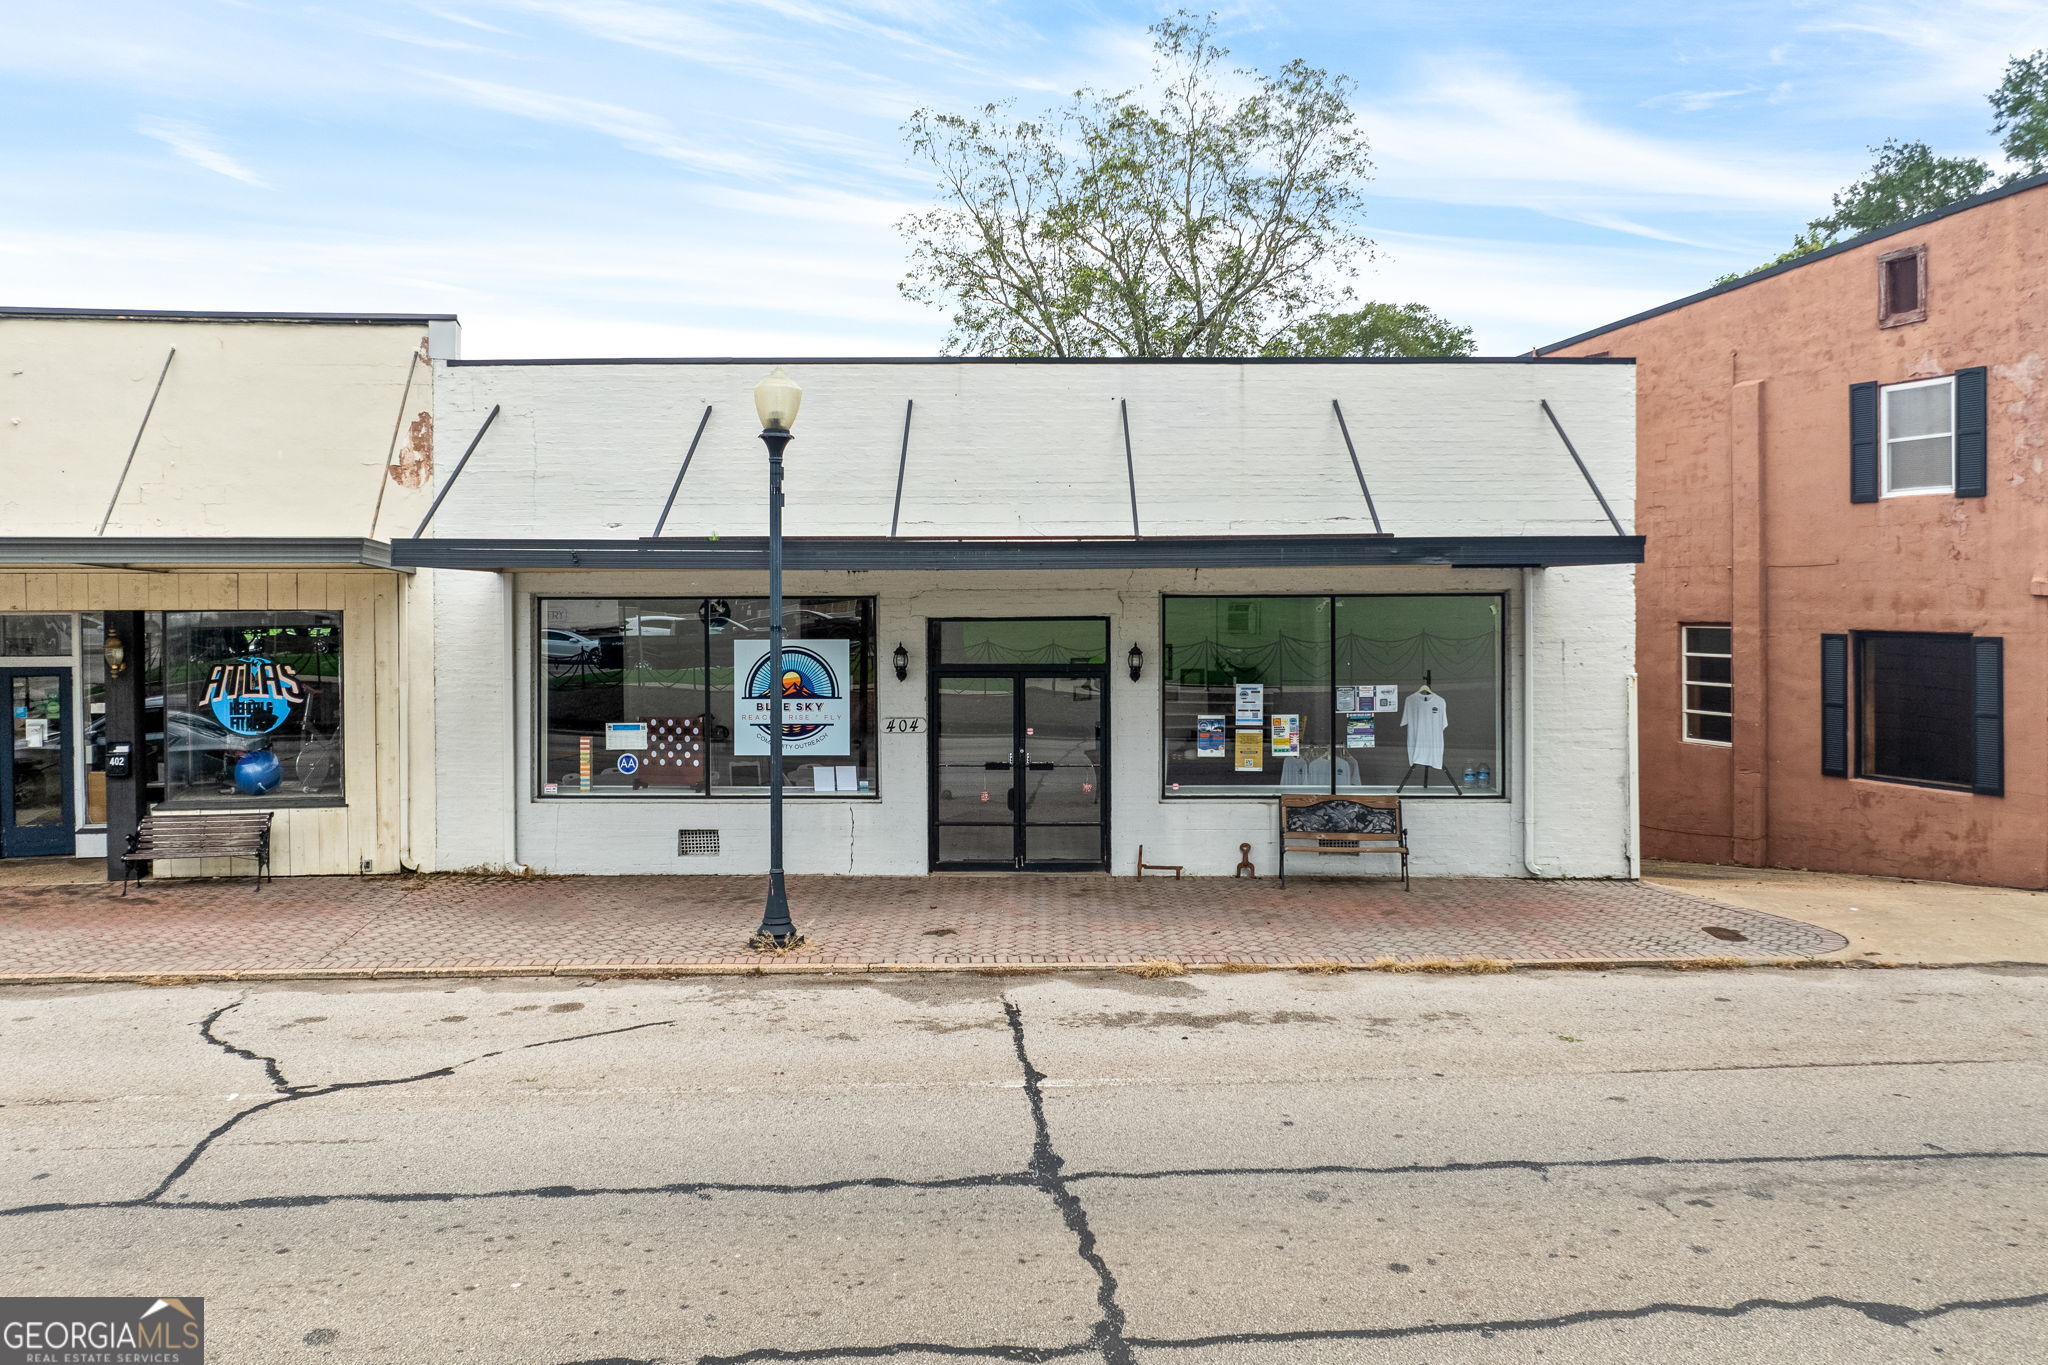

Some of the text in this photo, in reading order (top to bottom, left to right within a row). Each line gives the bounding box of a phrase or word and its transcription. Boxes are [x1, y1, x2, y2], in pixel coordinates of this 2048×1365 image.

[198, 662, 304, 707] ATLAS
[756, 702, 824, 712] BLE SKY
[886, 717, 919, 733] 404
[794, 732, 828, 750] OUTREACH
[109, 756, 125, 766] 402
[620, 758, 636, 769] AA
